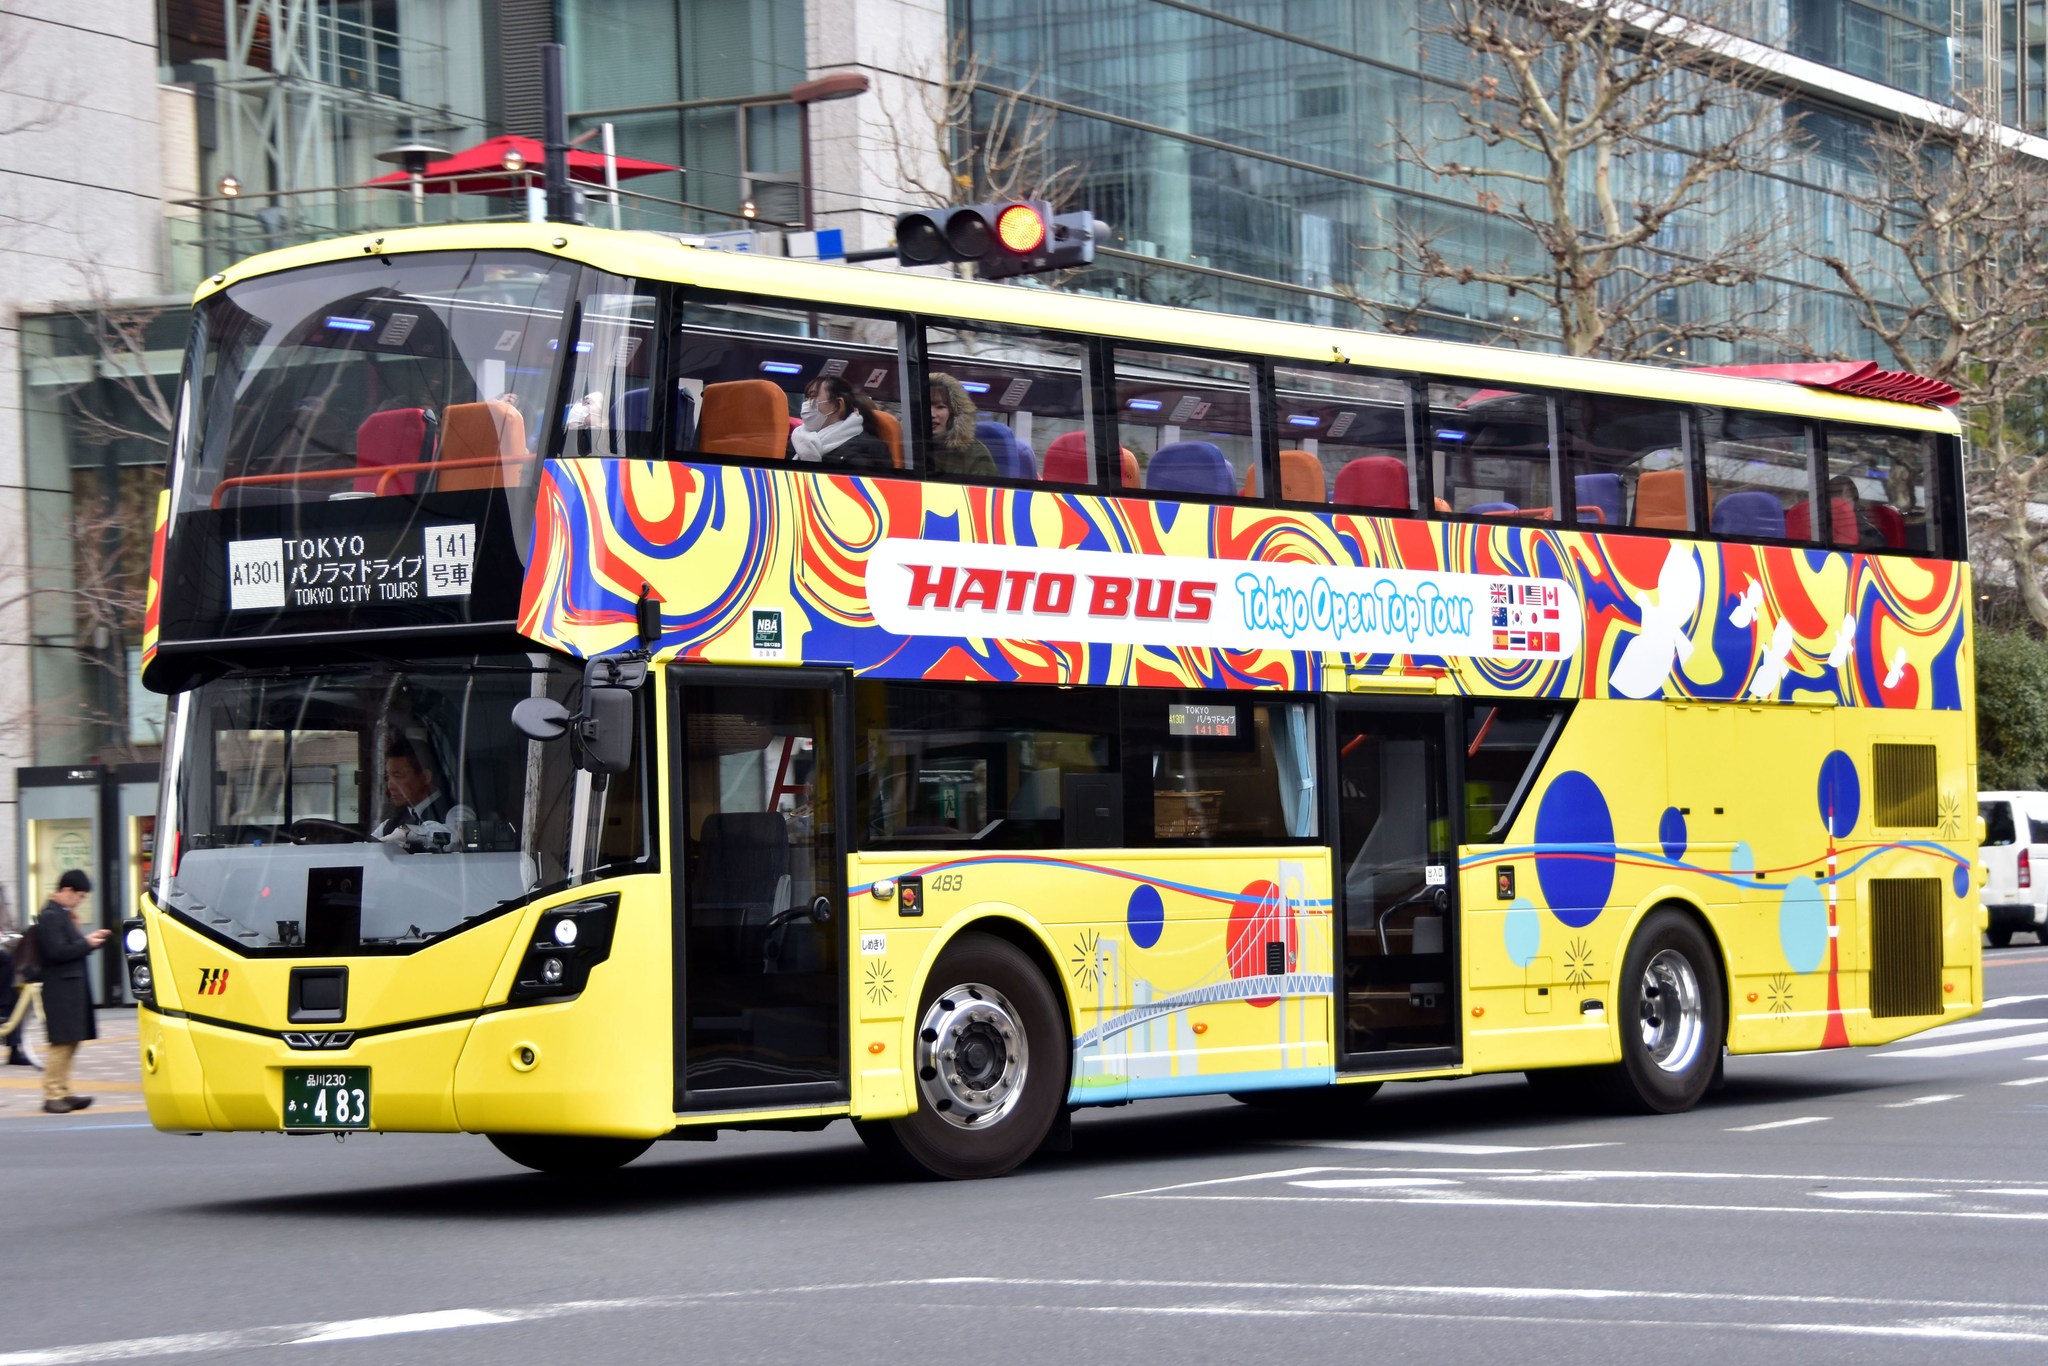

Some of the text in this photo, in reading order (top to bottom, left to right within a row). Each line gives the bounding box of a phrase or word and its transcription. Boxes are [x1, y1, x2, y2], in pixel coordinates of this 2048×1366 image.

[284, 535, 365, 560] TOKYO
[435, 533, 467, 558] 141
[233, 560, 280, 586] A1301
[290, 555, 425, 585] パノラマドライブ
[432, 563, 470, 588] 号車
[295, 581, 418, 606] TOKYO CITY TOURS
[897, 563, 1218, 623] HATO BUS
[1235, 572, 1474, 644] Tokyo Open Top Tour
[757, 618, 778, 631] NBA
[1169, 714, 1185, 724] A1301
[1185, 706, 1209, 715] TOKYO
[1195, 725, 1212, 735] 141
[931, 874, 963, 892] 483
[862, 938, 885, 951] しめきり
